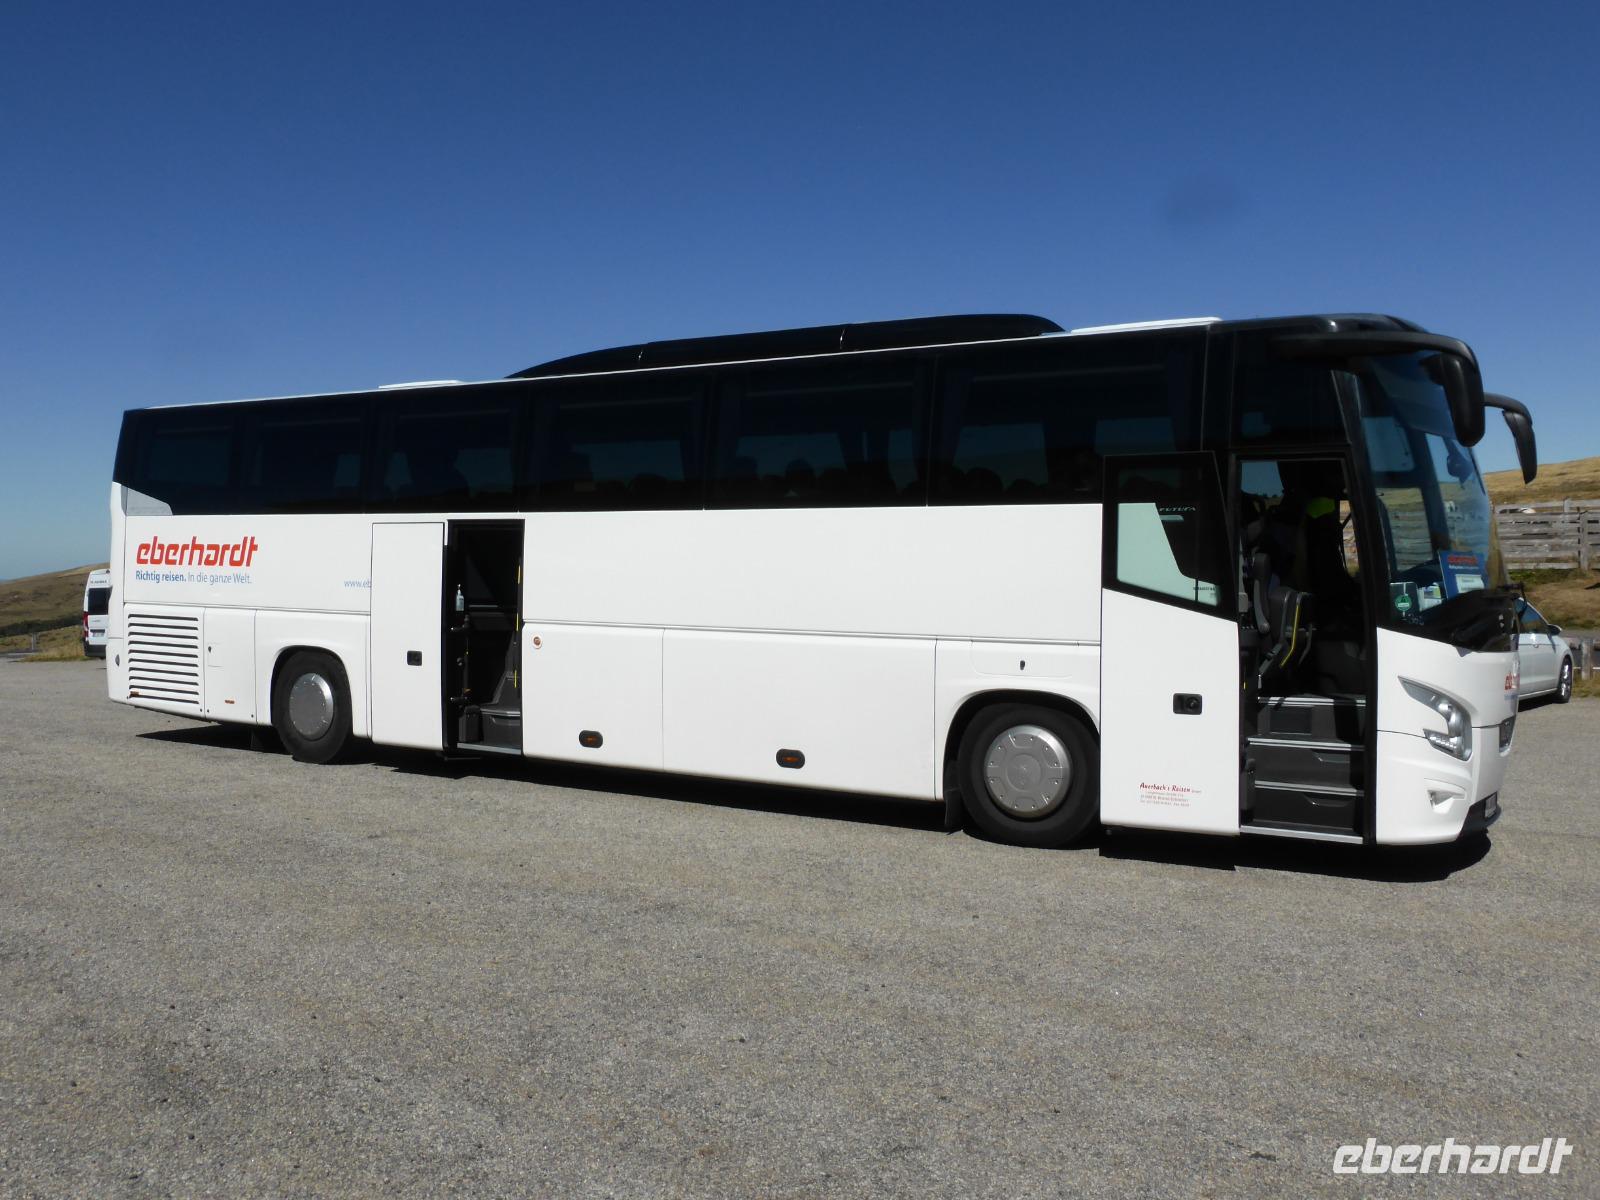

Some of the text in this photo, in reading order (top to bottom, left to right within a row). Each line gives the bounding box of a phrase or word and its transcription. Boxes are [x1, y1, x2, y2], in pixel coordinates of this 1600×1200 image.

[136, 535, 259, 567] eberhardt
[135, 569, 161, 584] Richtig
[161, 572, 187, 583] reisen.
[188, 571, 195, 583] In
[196, 571, 208, 583] die
[209, 575, 232, 586] ganze
